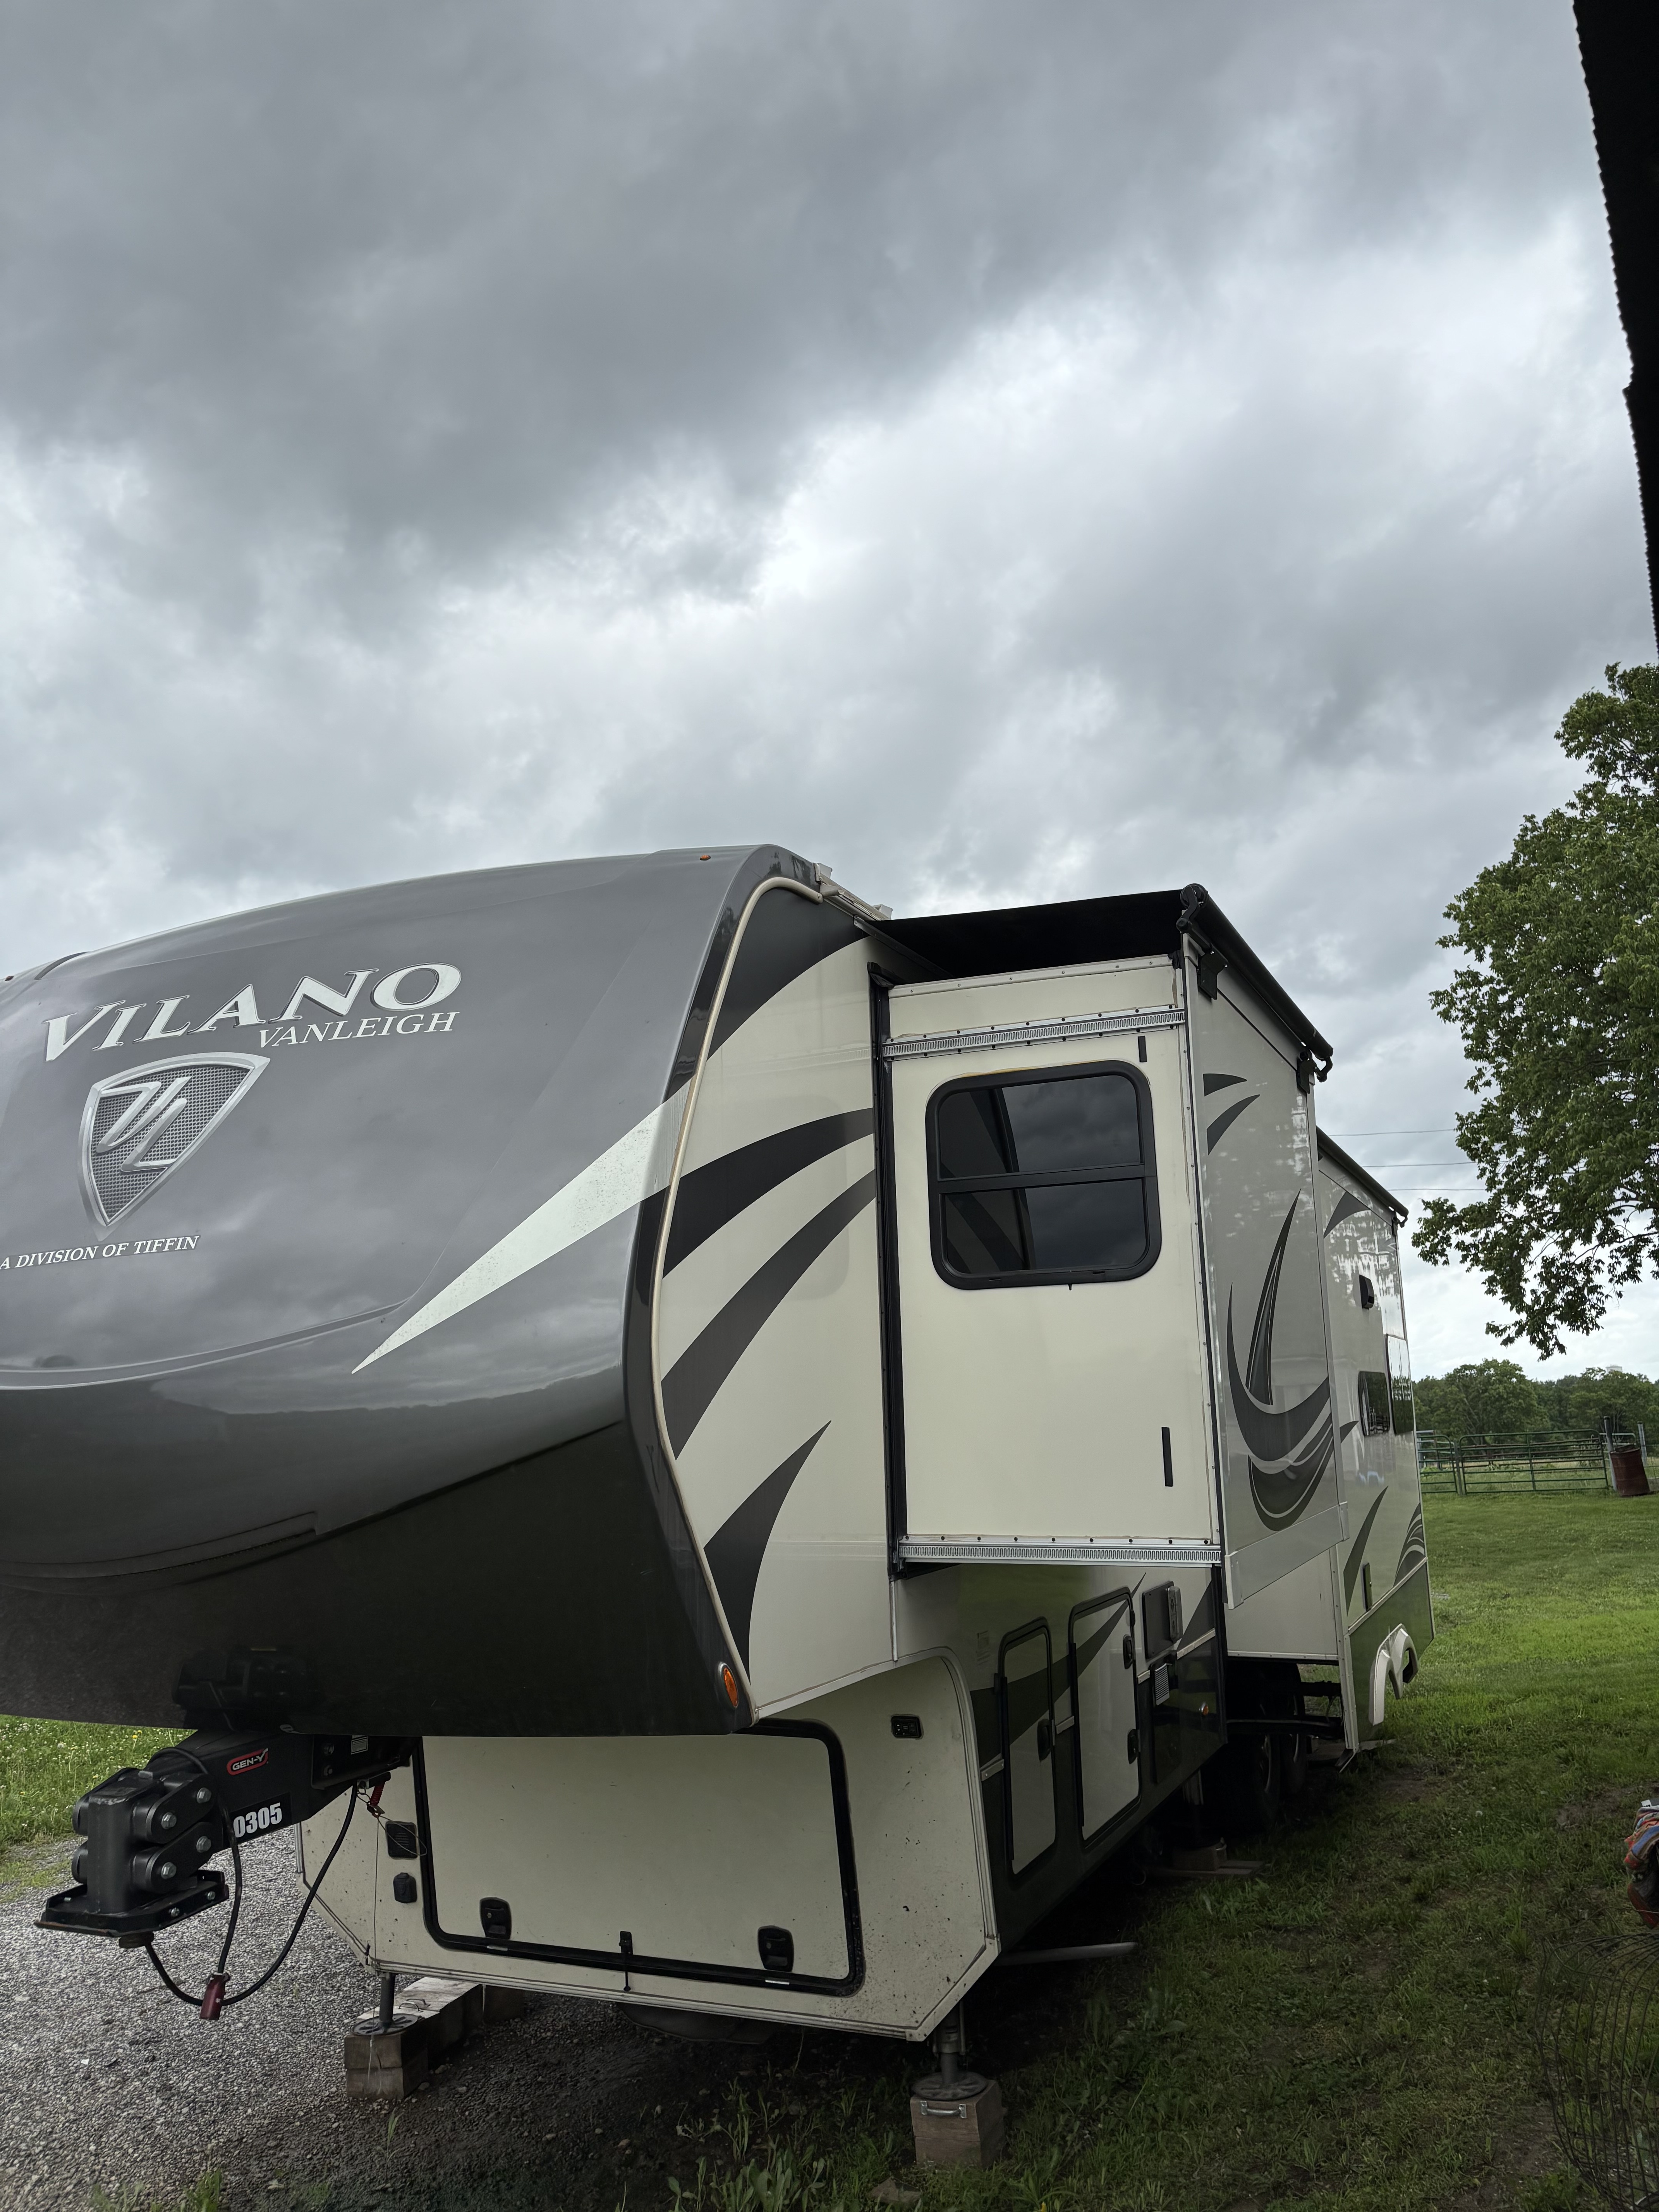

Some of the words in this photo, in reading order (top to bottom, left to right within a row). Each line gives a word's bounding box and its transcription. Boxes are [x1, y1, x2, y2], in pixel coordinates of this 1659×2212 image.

[42, 962, 462, 1062] VILANO
[259, 1012, 460, 1048] VANLEIGH
[0, 1257, 10, 1270] A
[15, 1246, 99, 1268] DIVISION
[102, 1242, 129, 1257] OF
[134, 1236, 200, 1254] TIFFIN
[232, 1748, 268, 1771] GEN-Y
[233, 1802, 282, 1838] 0305
